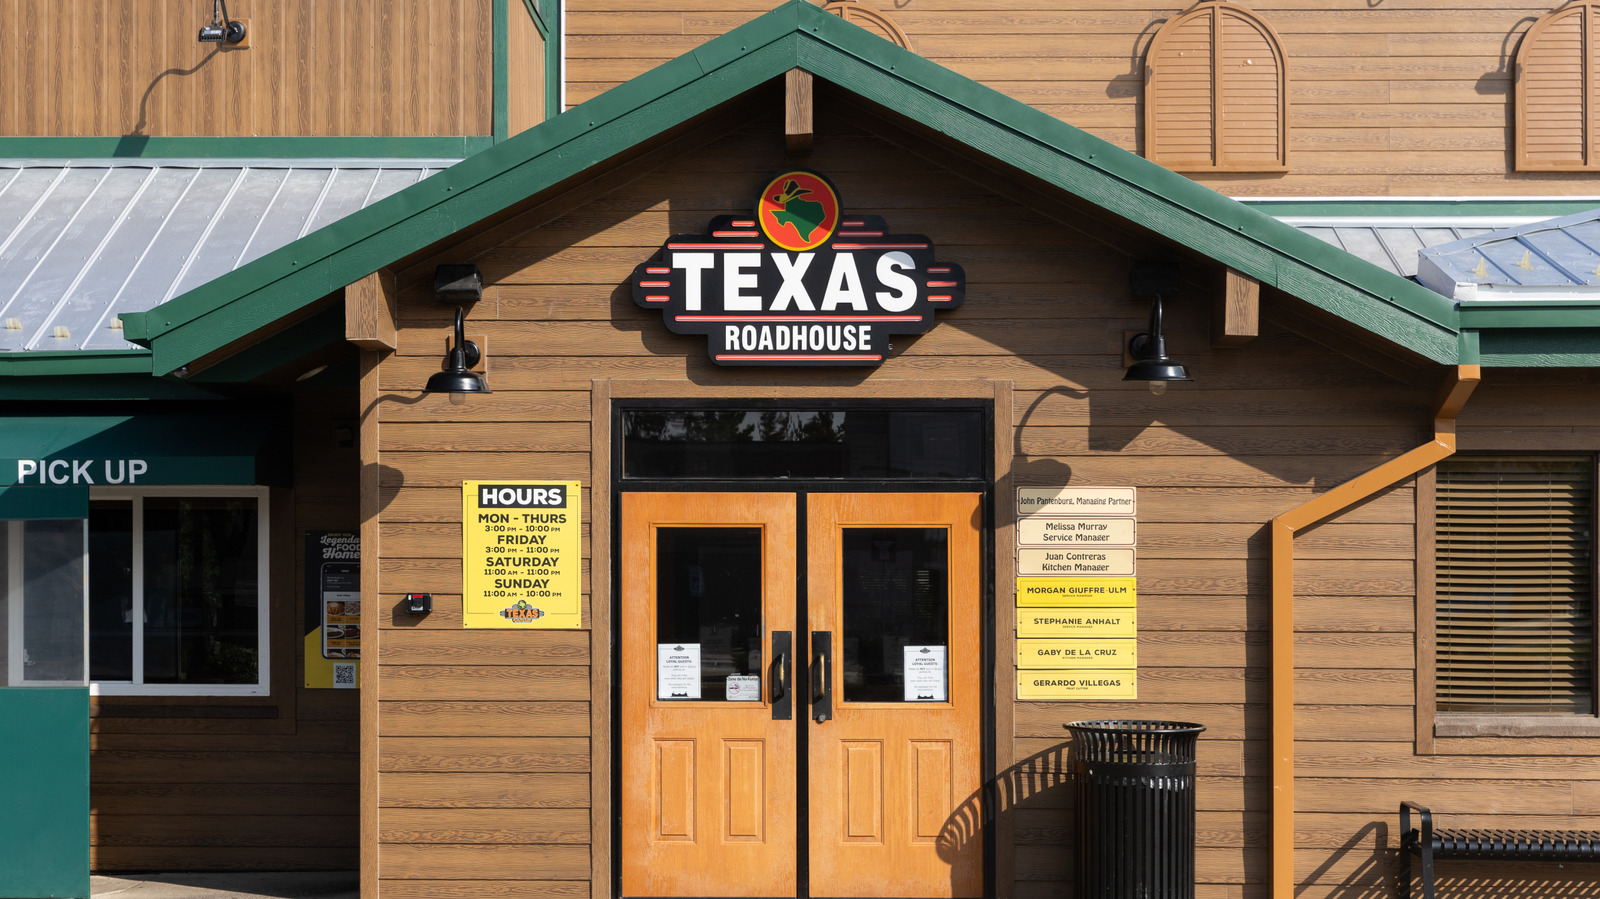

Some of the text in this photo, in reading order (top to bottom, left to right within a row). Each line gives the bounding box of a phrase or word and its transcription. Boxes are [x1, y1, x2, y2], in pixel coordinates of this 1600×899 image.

[672, 251, 917, 312] TEXAS
[725, 325, 871, 351] ROADHOUSE
[17, 459, 148, 485] PICK UP
[482, 488, 562, 505] HOURS
[1020, 497, 1131, 505] John Pantenburg, Managing Partner
[478, 513, 509, 523] MON
[522, 513, 567, 523] THURS
[1045, 522, 1108, 531] Melissa Murray
[497, 535, 547, 544] FRIDAY
[1043, 533, 1110, 542] Service Manager
[1045, 552, 1106, 560] Juan Contreras
[486, 557, 559, 567] SATURDAY
[1042, 563, 1110, 571] Kitchen Manager
[494, 579, 550, 589] SUNDAY
[506, 609, 539, 618] TEXAS
